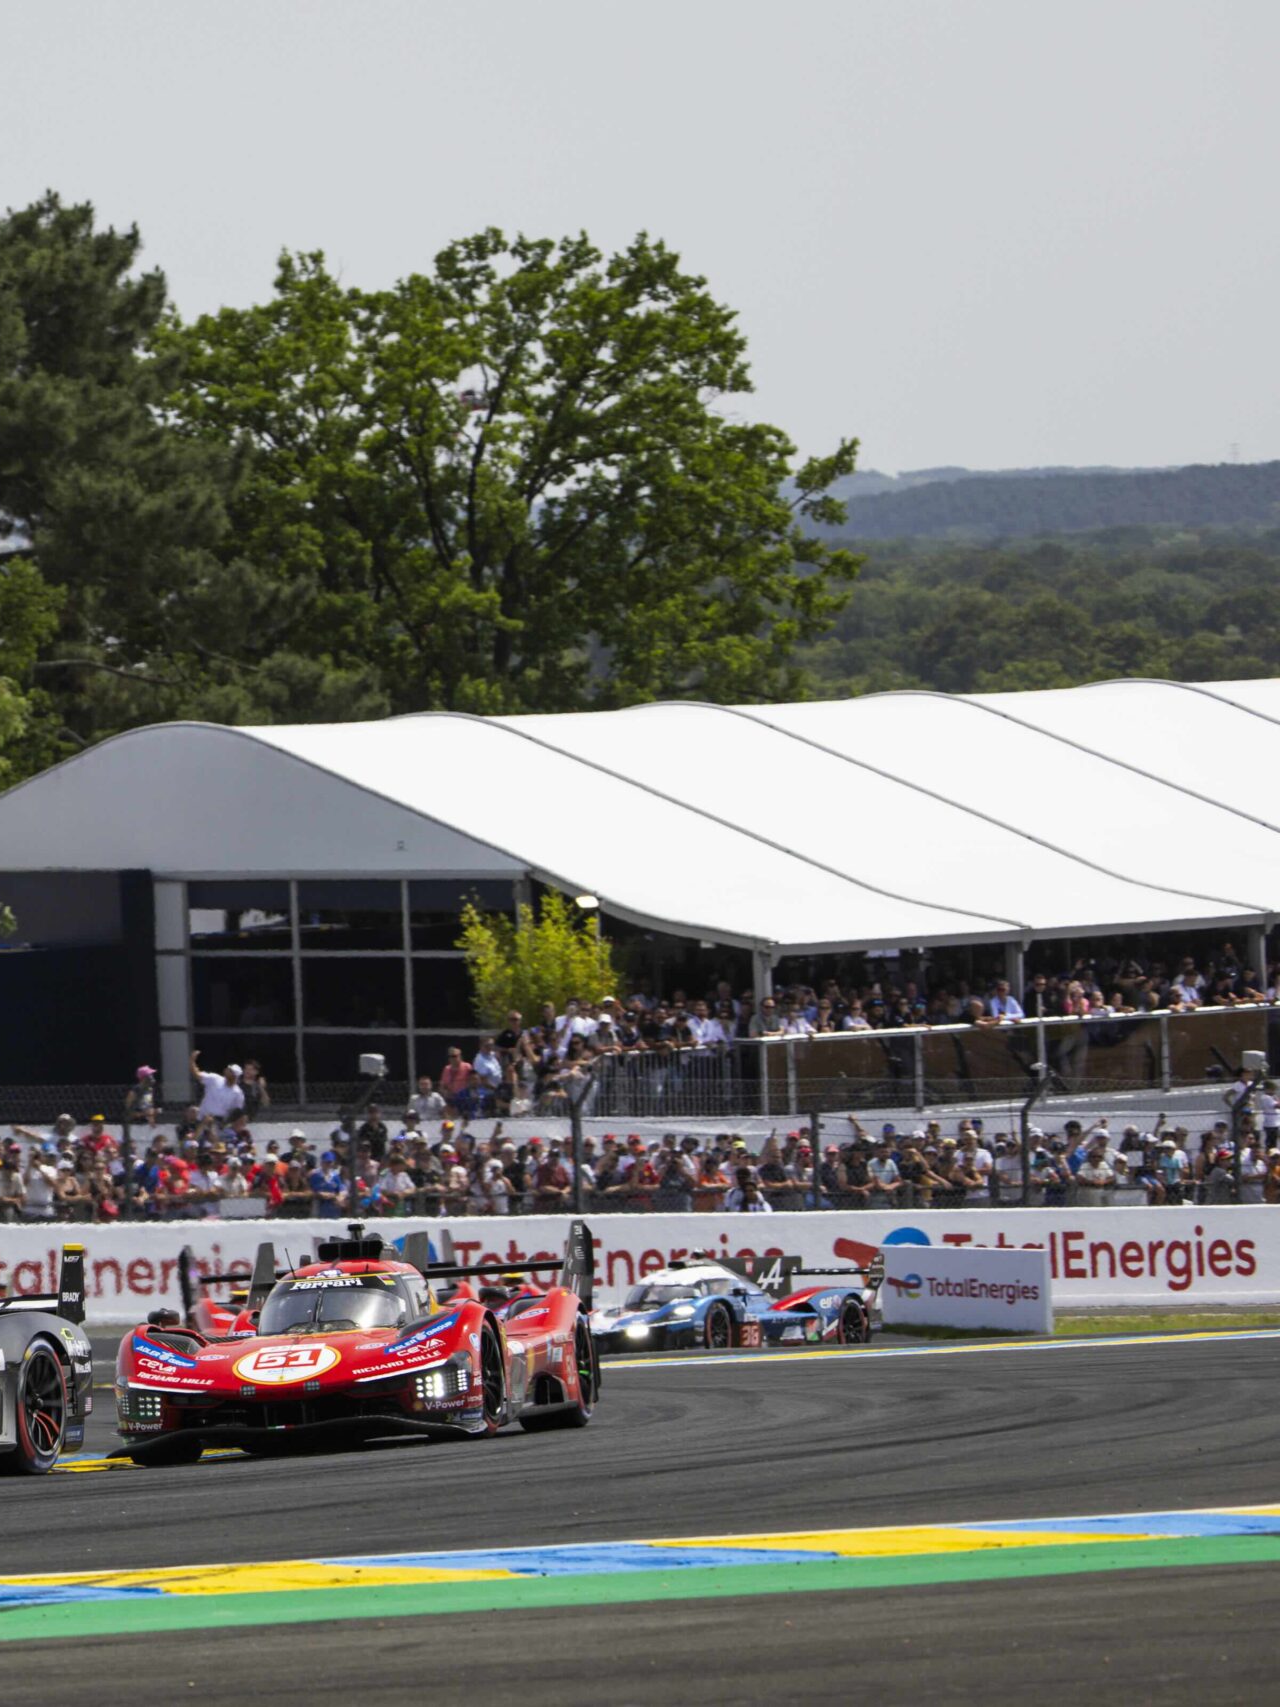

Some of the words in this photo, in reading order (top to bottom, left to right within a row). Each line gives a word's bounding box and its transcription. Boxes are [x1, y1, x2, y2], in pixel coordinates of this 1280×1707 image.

[943, 1225, 1256, 1291] lEnergies
[289, 1278, 364, 1291] Ferrari
[926, 1276, 1040, 1305] TotalEnergies
[62, 1291, 81, 1303] BRADY
[388, 1337, 419, 1353] ADLER
[426, 1320, 453, 1336] GROUP
[136, 1345, 160, 1357] ADLER
[257, 1350, 316, 1367] 51
[352, 1360, 405, 1375] RICHARD
[406, 1350, 442, 1364] MILLE
[137, 1371, 181, 1383] RICHARD
[180, 1377, 215, 1386] MILLE
[425, 1400, 465, 1411] V-Power
[128, 1421, 163, 1431] V-Power
